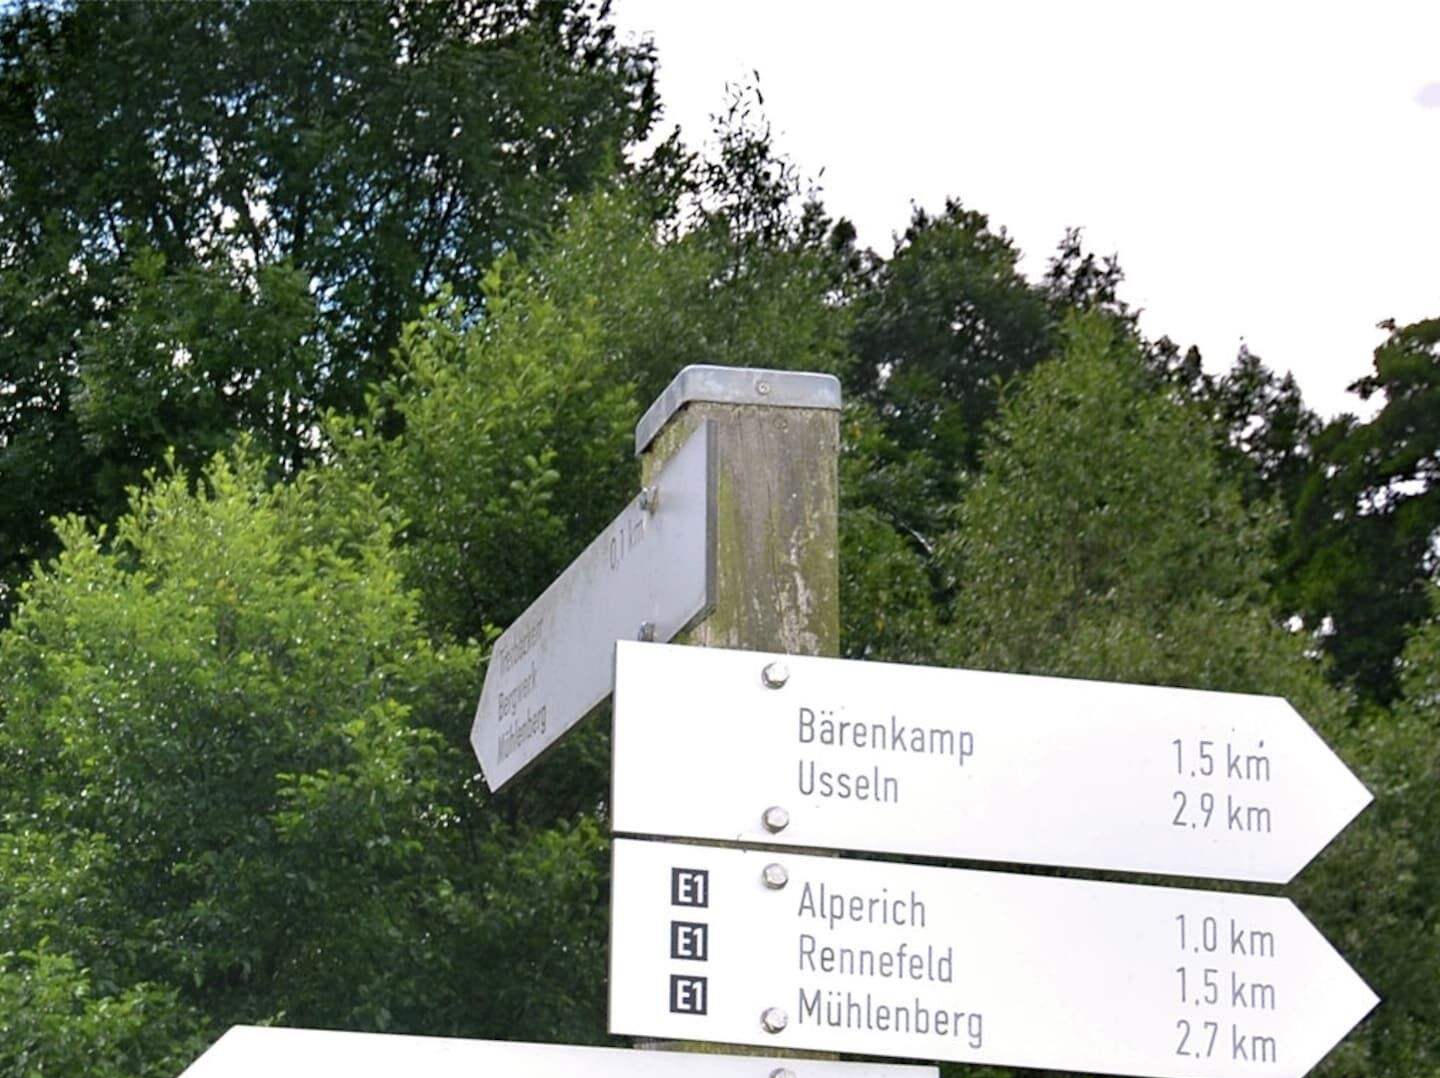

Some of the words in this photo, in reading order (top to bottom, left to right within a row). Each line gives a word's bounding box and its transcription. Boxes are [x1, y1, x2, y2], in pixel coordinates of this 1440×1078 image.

[798, 706, 974, 767] Bärenkamp
[1226, 743, 1270, 782] km
[798, 759, 899, 804] Usseln
[1227, 794, 1272, 833] km
[678, 872, 705, 904] E1
[797, 881, 926, 931] Alperich
[1230, 918, 1275, 958] km
[677, 925, 704, 958] E1
[799, 933, 953, 983] Rennefeld
[1231, 970, 1276, 1011] km
[676, 979, 703, 1011] E1
[798, 987, 983, 1049] Mühlenberg
[1231, 1023, 1277, 1063] km
